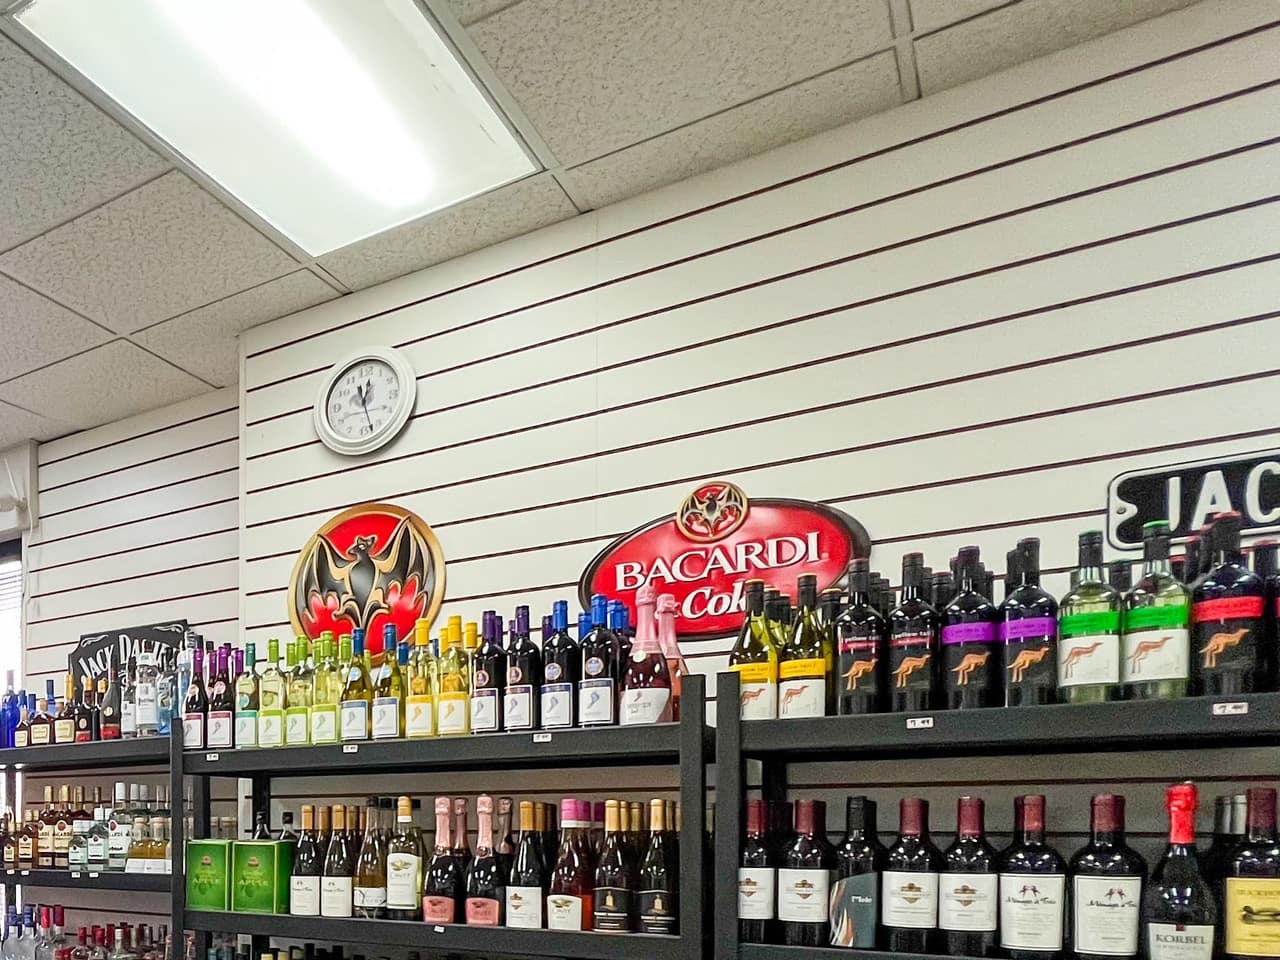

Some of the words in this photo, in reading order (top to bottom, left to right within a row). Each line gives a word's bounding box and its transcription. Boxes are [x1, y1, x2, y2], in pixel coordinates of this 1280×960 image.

[614, 530, 821, 593] BACARDI
[680, 579, 748, 620] Cok
[1155, 933, 1207, 945] KORBEL
